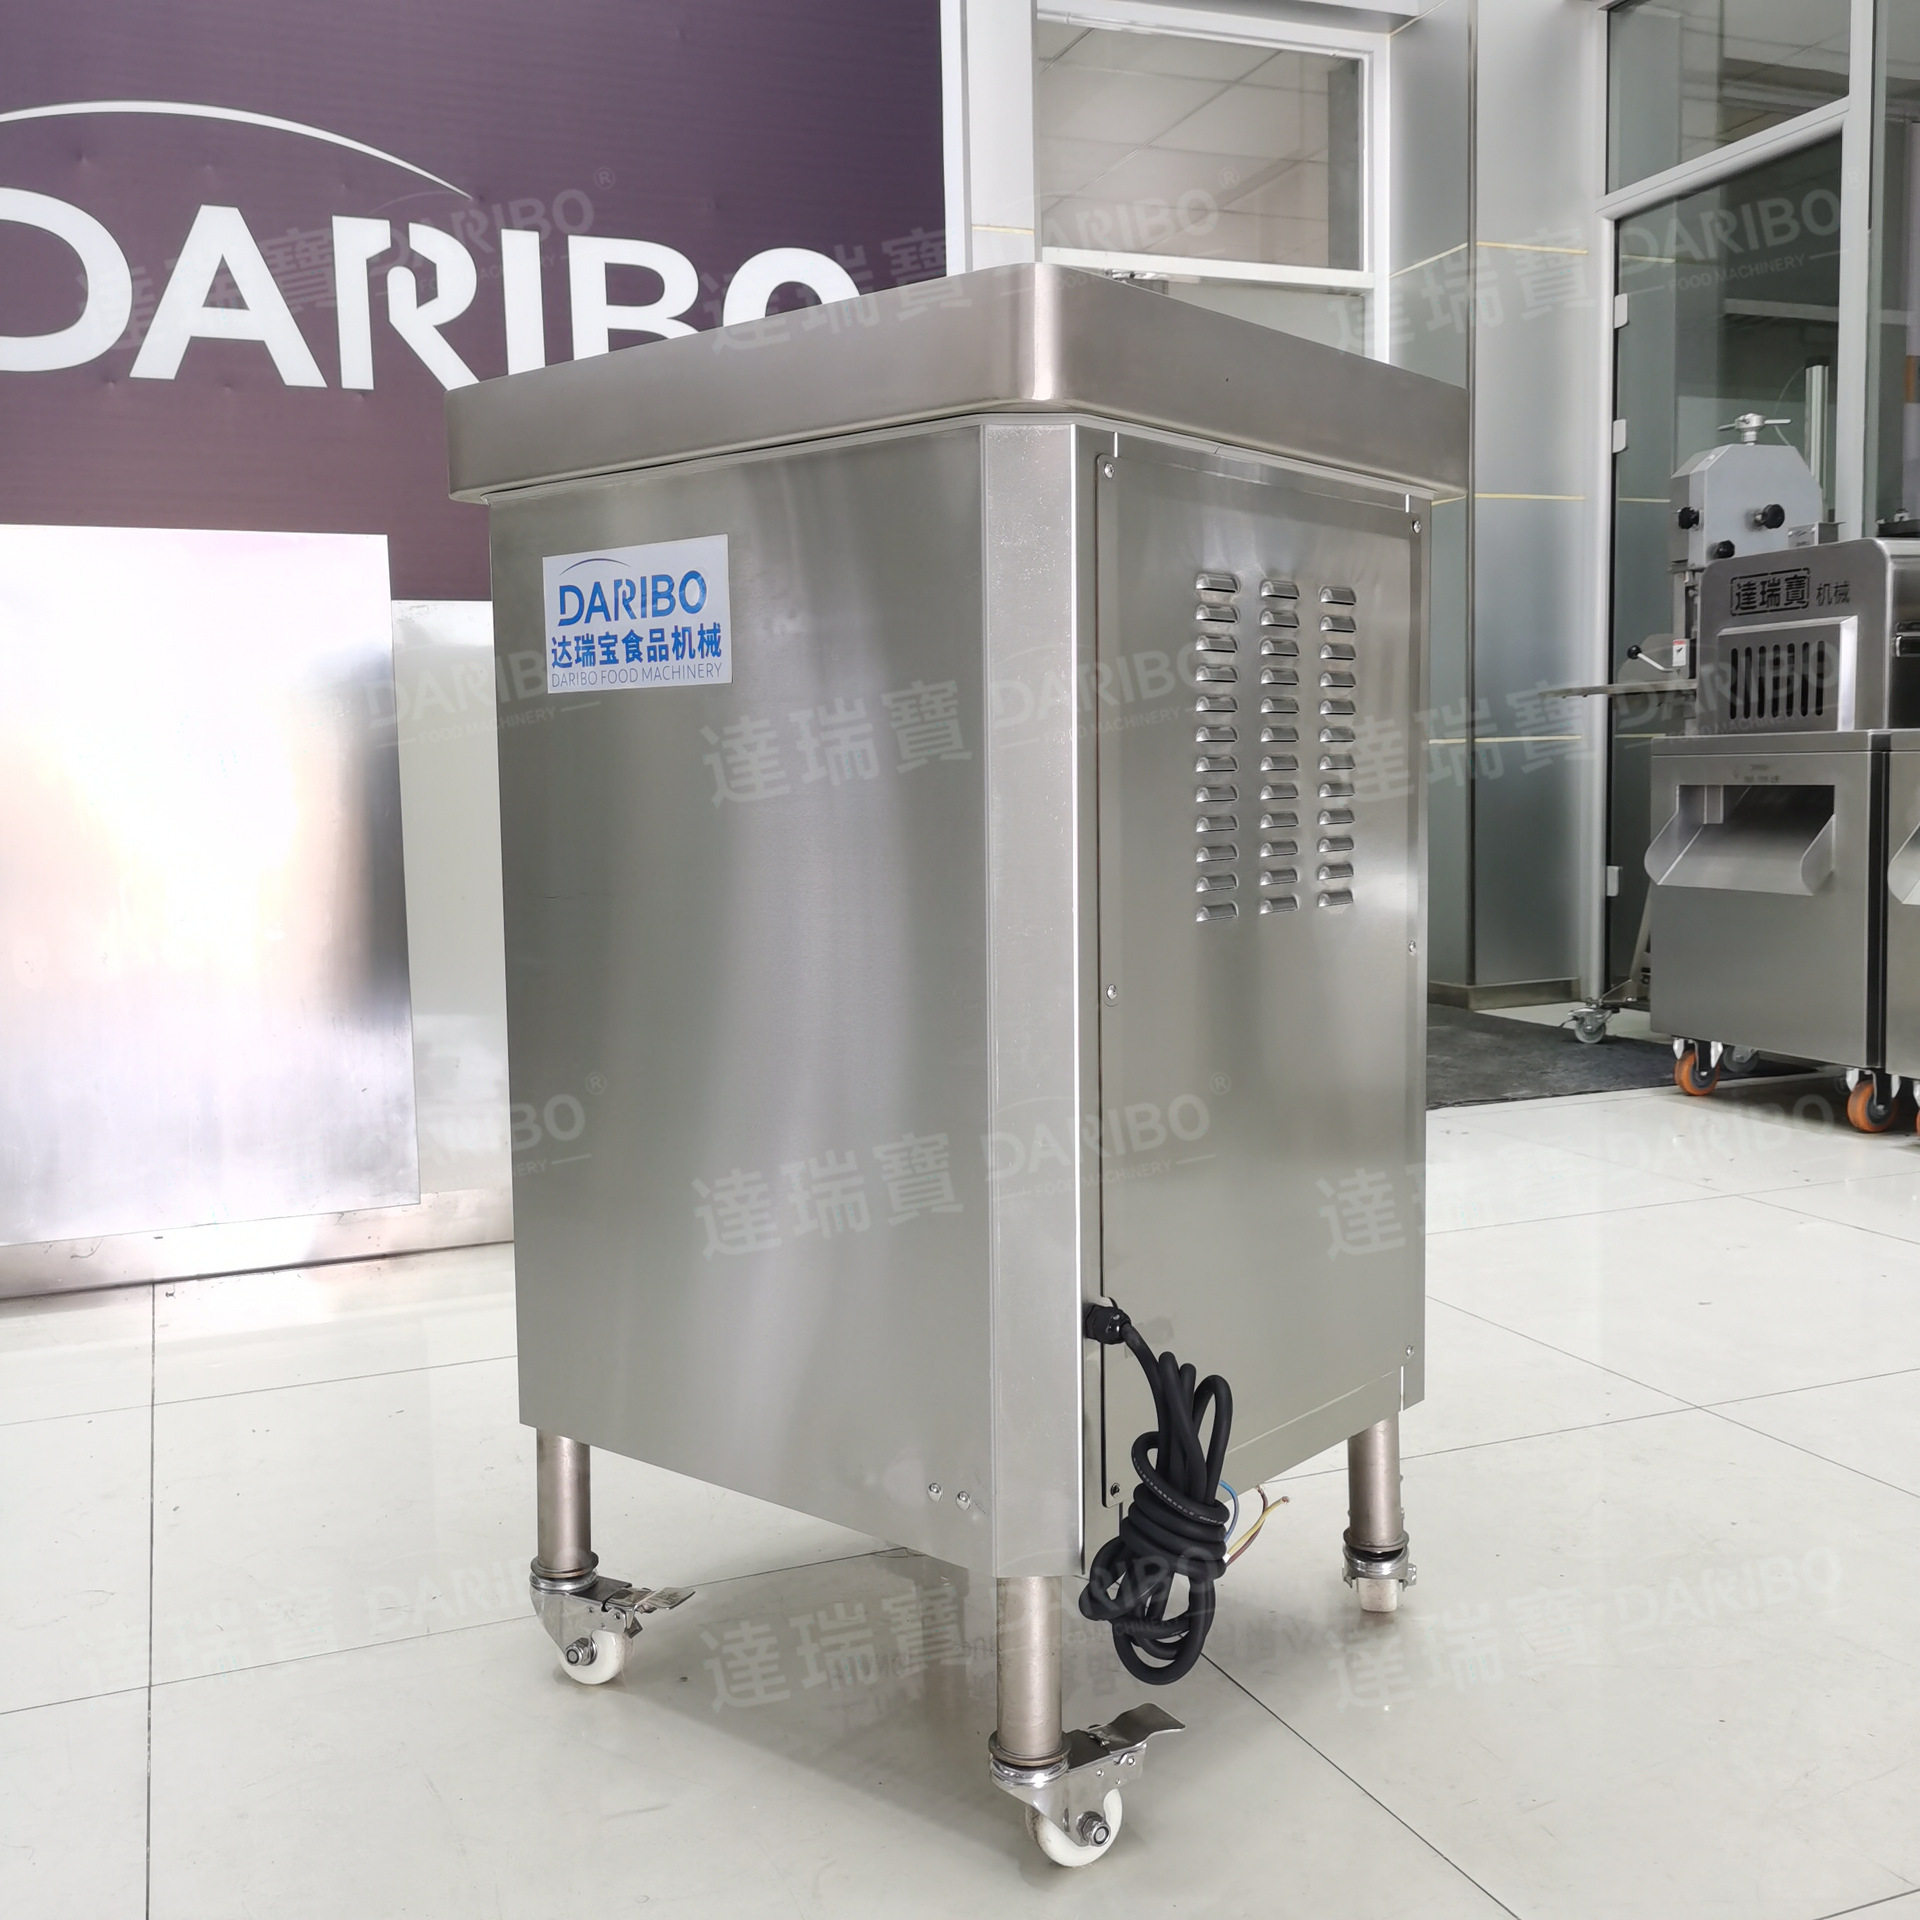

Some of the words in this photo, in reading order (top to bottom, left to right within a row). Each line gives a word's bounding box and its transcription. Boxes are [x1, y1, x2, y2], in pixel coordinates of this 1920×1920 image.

[557, 569, 707, 627] DARIBO
[551, 621, 722, 669] 达瑞宝食品机械
[551, 671, 598, 688] DARIBO
[601, 668, 639, 685] FOOD
[642, 662, 723, 682] MACHINERY
